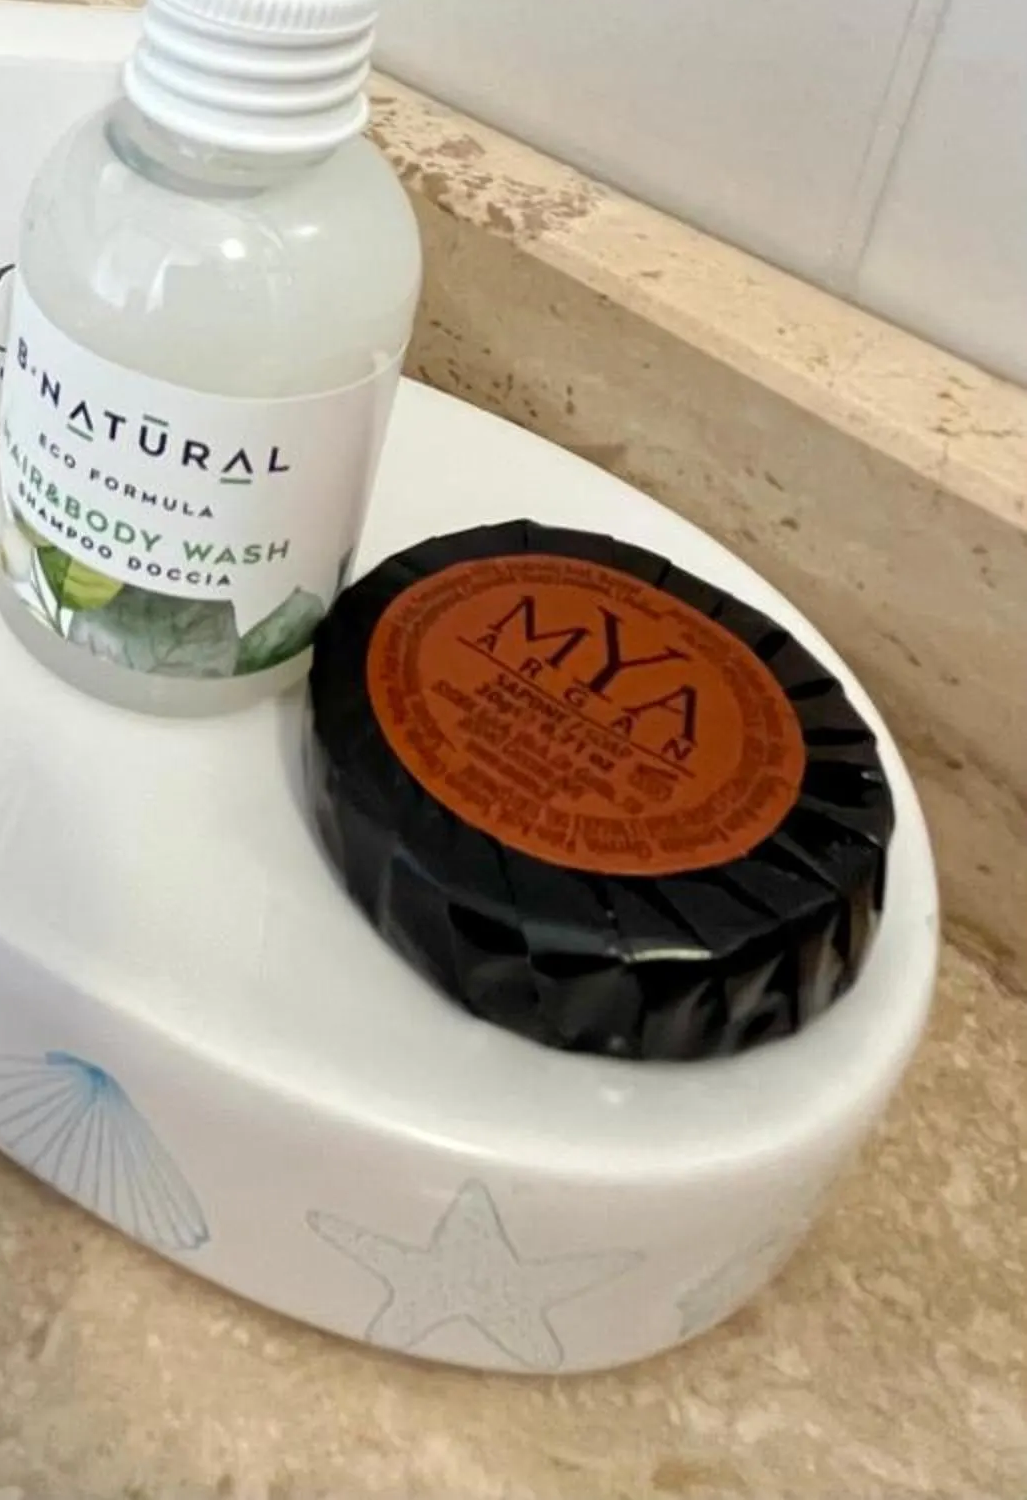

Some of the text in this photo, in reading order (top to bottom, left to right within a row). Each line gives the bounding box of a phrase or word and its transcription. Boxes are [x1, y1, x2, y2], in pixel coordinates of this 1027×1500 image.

[38, 432, 214, 520] ECO FORMULA
[18, 481, 233, 587] SHAMPOO DOCCIA
[182, 539, 291, 567] WASH
[476, 630, 697, 763] ARGAN
[487, 596, 697, 749] MYA
